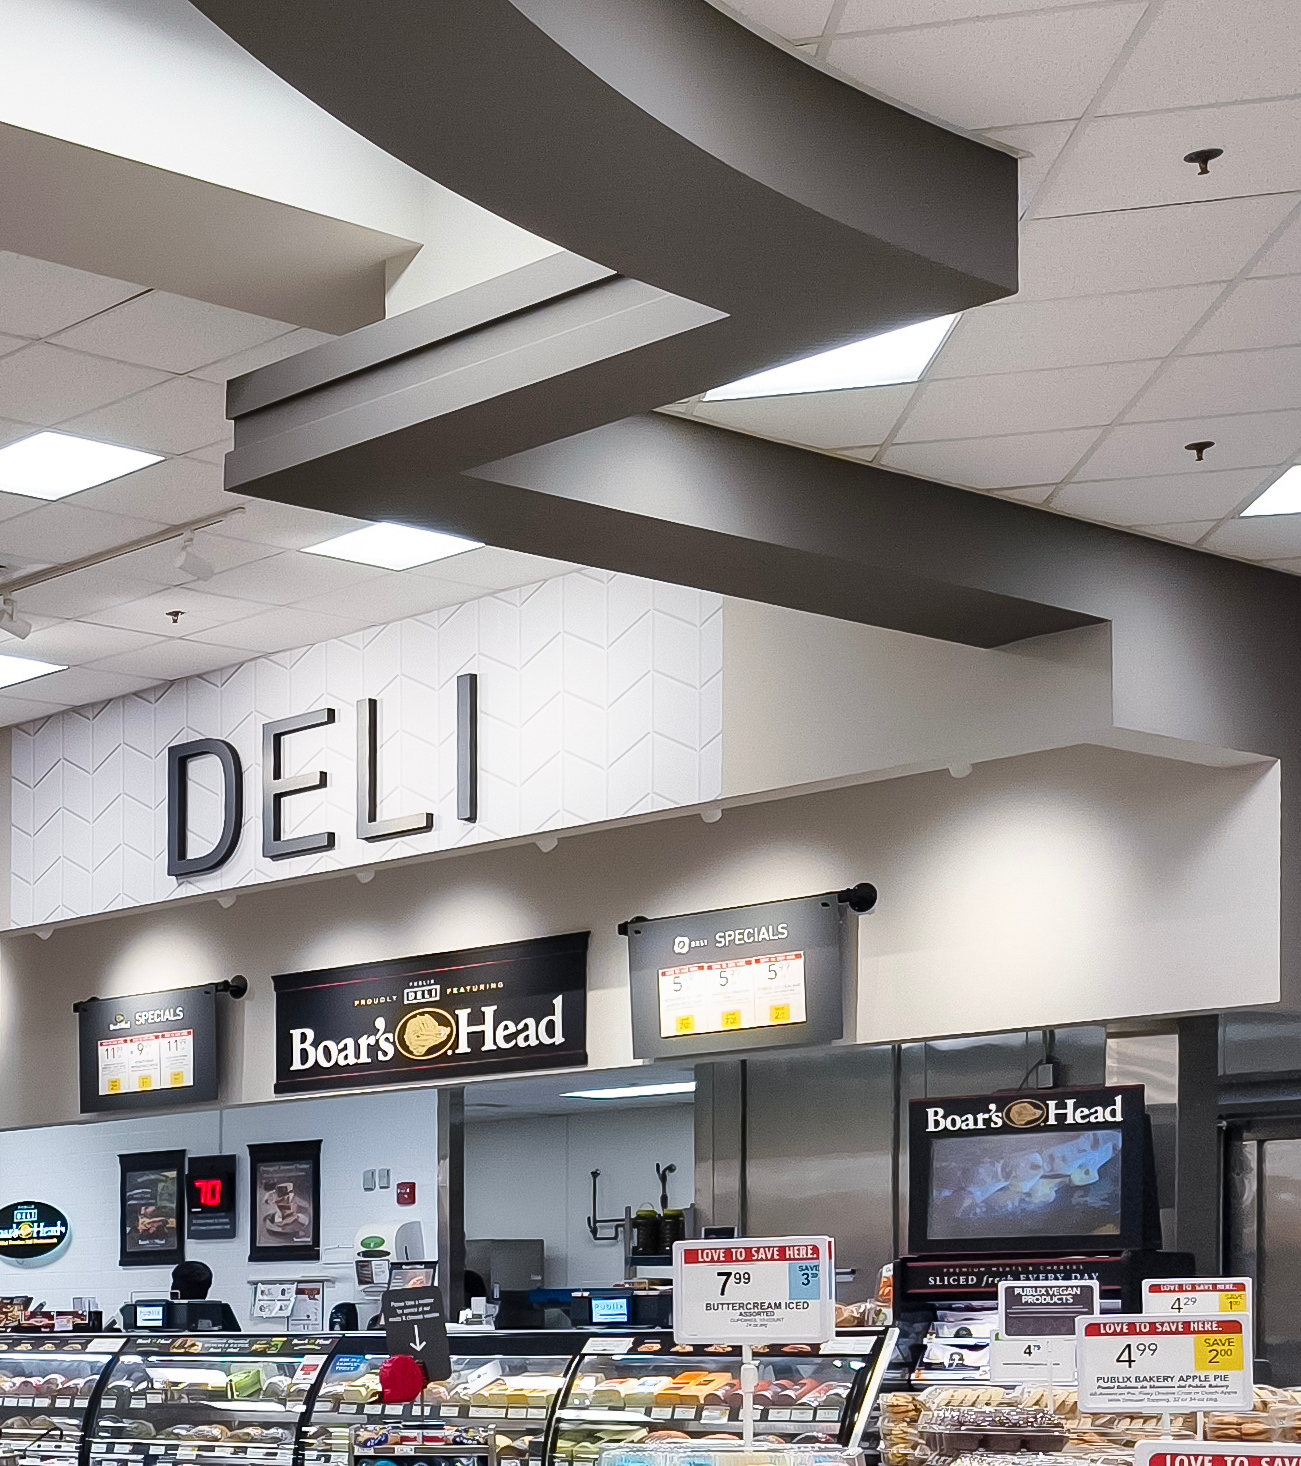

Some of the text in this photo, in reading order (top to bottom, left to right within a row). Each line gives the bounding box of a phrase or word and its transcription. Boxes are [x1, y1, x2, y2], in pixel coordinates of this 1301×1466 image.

[166, 673, 478, 878] DELI
[715, 923, 788, 947] SPECIALS
[354, 981, 504, 1007] PROUDLY DELI FEATURING
[135, 1006, 184, 1026] SPECIALS
[290, 994, 566, 1070] Boar's Head
[925, 1095, 1123, 1132] Boar's Head
[698, 1245, 817, 1262] LOVE TO SAVE HERE.
[928, 1275, 977, 1286] SLICED
[1014, 1286, 1080, 1296] PUBLIX VEGAN
[1021, 1294, 1074, 1304] PRODUCTS
[705, 1301, 809, 1312] BUTTERCREAM ICED
[738, 1310, 775, 1318] ASSORTED
[1100, 1320, 1223, 1334] LOVE TO SAVE HERE.
[1203, 1337, 1235, 1347] SAVE
[1096, 1374, 1230, 1384] PUBLIX BAKERY APPLE PIE
